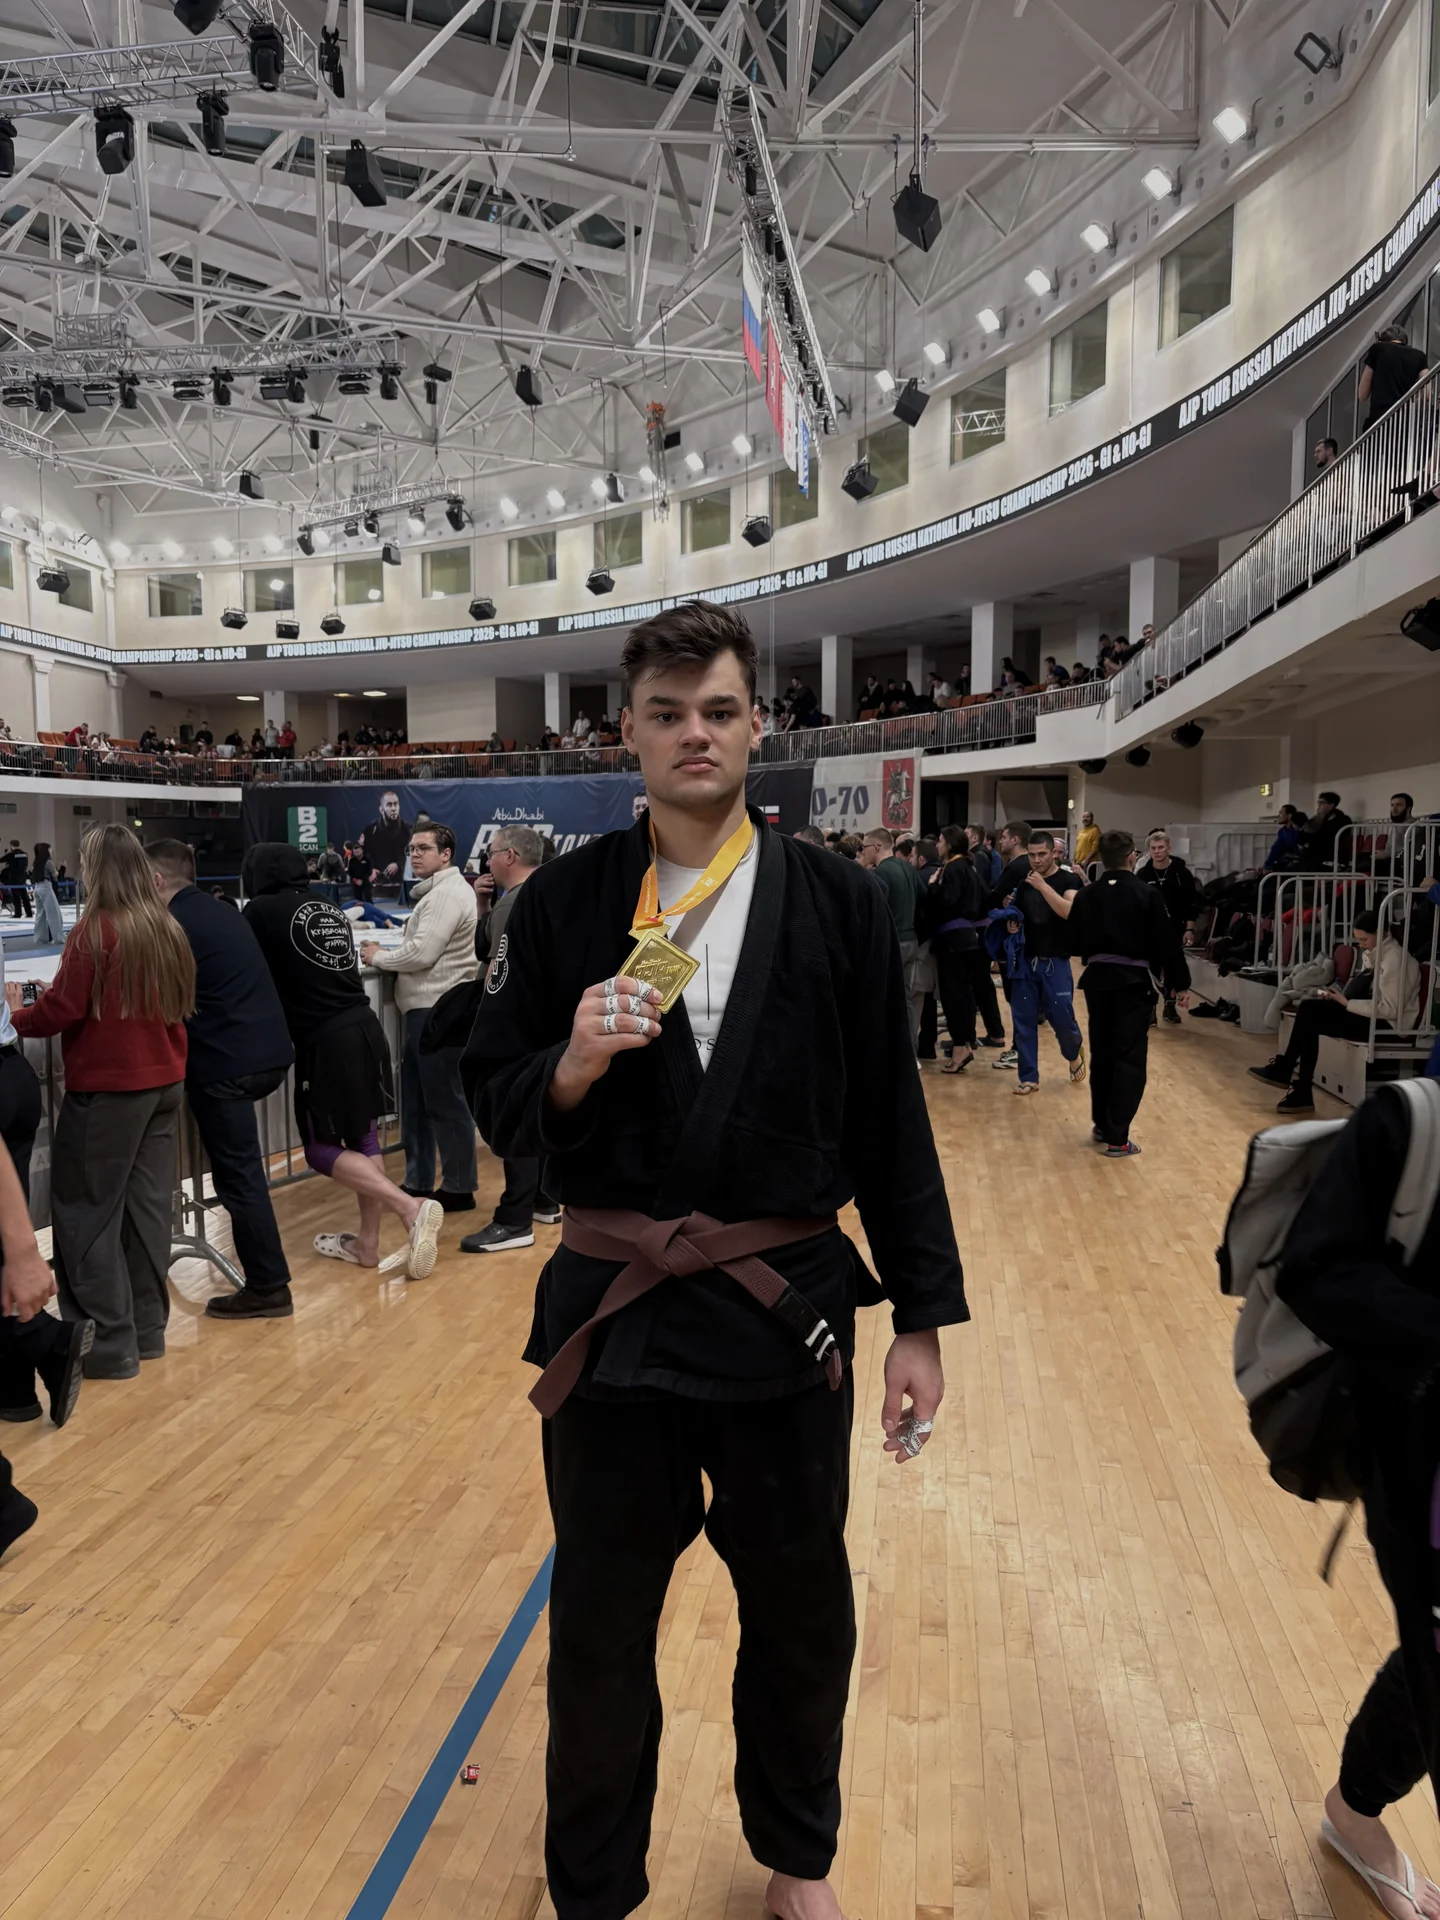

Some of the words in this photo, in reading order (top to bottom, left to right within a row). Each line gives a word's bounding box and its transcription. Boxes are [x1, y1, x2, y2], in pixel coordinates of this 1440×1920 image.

[1179, 395, 1200, 429] AJP
[1201, 375, 1231, 416] TOUR
[1232, 344, 1272, 397] RUSSIA
[1273, 300, 1327, 367] NATIONAL
[1328, 247, 1383, 324] JIU-JITSU
[847, 551, 862, 571] AJP
[862, 543, 884, 566] TOUR
[885, 532, 917, 559] RUSSIA
[918, 516, 958, 549] NATIONAL
[958, 499, 1000, 534] JIU-JITSU
[1001, 468, 1067, 517] CHAMPIONSHIP
[1068, 454, 1094, 486] 2026
[1100, 444, 1112, 470] GI
[1113, 444, 1121, 464] &
[1122, 422, 1152, 460] NO-GI
[558, 616, 573, 631] AJP
[573, 613, 594, 629] TOUR
[595, 608, 624, 626] RUSSIA
[625, 601, 661, 621] NATIONAL
[759, 574, 781, 595] 2026
[786, 570, 796, 588] GI
[796, 570, 803, 585] &
[804, 561, 828, 583] NO-GI
[111, 650, 175, 663] CHAMPIONSHIP
[175, 648, 199, 661] 2026
[204, 648, 215, 660] GI
[222, 646, 247, 660] NO-GI
[266, 645, 282, 658] AJP
[282, 643, 305, 656] TOUR
[305, 641, 336, 655] RUSSIA
[336, 638, 375, 653] NATIONAL
[375, 635, 412, 650] JIU-JITSU
[412, 629, 473, 647] CHAMPIONSHIP
[473, 626, 495, 641] 2026
[499, 624, 509, 639] GI
[516, 620, 539, 637] NO-GI
[811, 818, 858, 828] СКВА
[299, 843, 319, 851] SCAN
